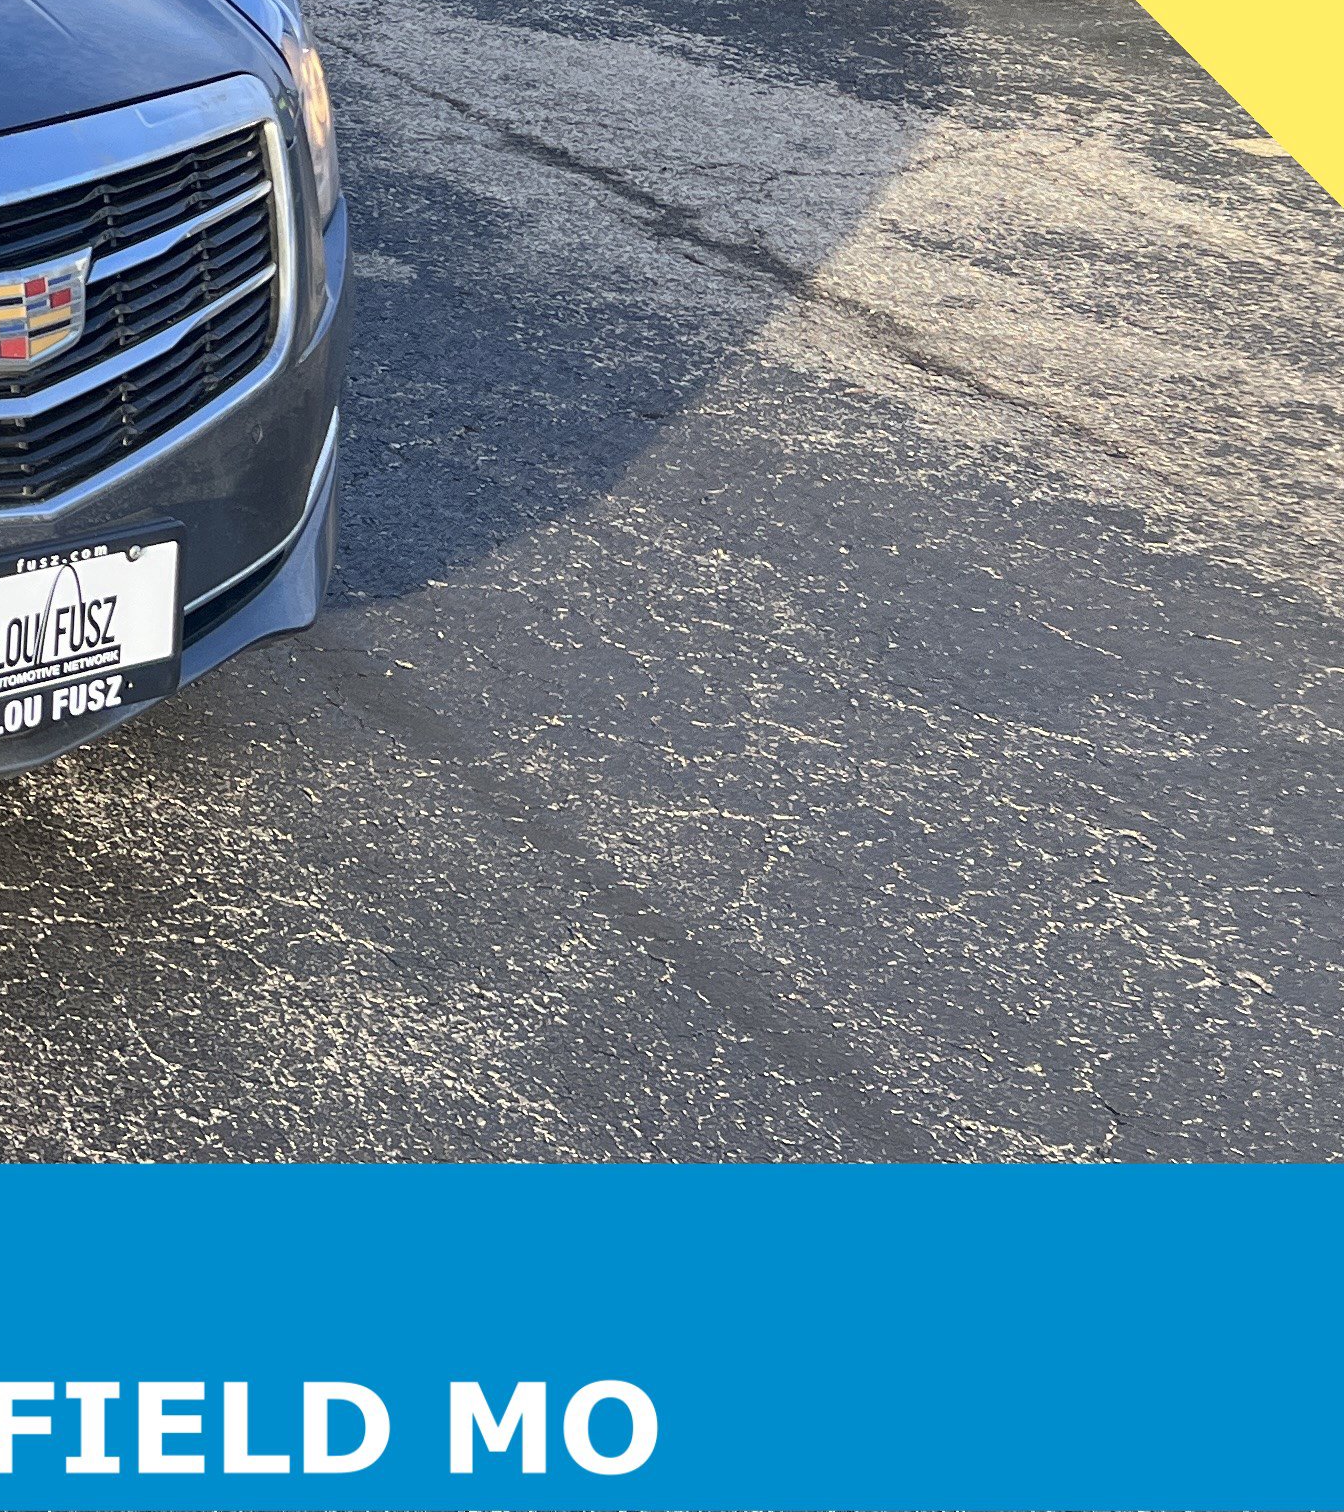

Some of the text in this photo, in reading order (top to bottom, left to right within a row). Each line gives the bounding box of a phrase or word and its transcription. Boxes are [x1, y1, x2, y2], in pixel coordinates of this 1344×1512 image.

[16, 545, 108, 573] fusz.com
[54, 595, 118, 657] FUSZ
[63, 650, 120, 678] NETWORK
[52, 675, 122, 721] FUSZ
